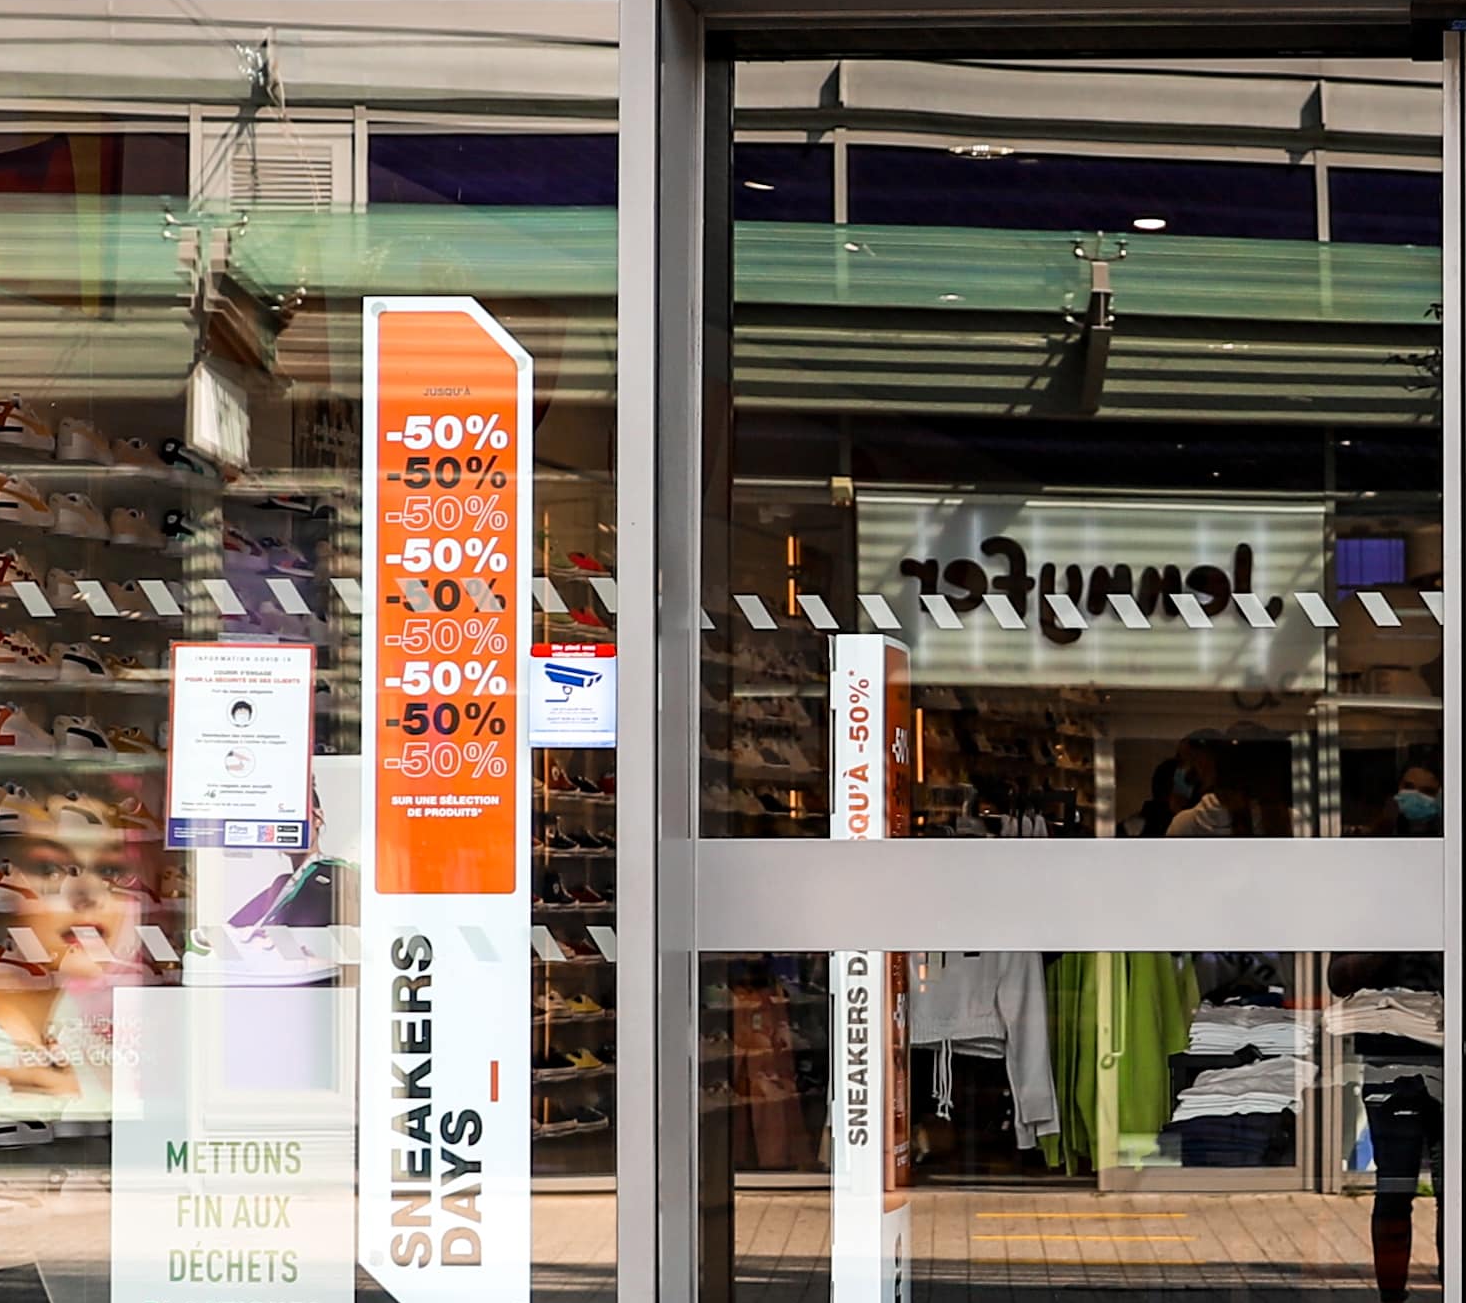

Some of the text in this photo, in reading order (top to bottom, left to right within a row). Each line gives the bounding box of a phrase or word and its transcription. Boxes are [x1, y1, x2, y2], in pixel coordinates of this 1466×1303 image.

[385, 414, 508, 450] -50%
[385, 456, 508, 489] -50%
[385, 494, 508, 532] -50%
[385, 538, 508, 573] -50%
[385, 579, 508, 613] -50%
[385, 617, 508, 655] -50%
[385, 660, 508, 696] -50%
[385, 701, 508, 736] -50%
[385, 741, 508, 779] -50%
[391, 793, 499, 805] SUR UNE SÉLECTION
[407, 808, 422, 817] DE
[847, 986, 869, 1146] SNEAKERS
[389, 932, 433, 1270] SNEAKERS
[166, 1141, 302, 1174] METTONS
[439, 1107, 483, 1268] DAYS
[177, 1195, 290, 1228] FIN AUX
[168, 1240, 298, 1283] DÉCHETS
